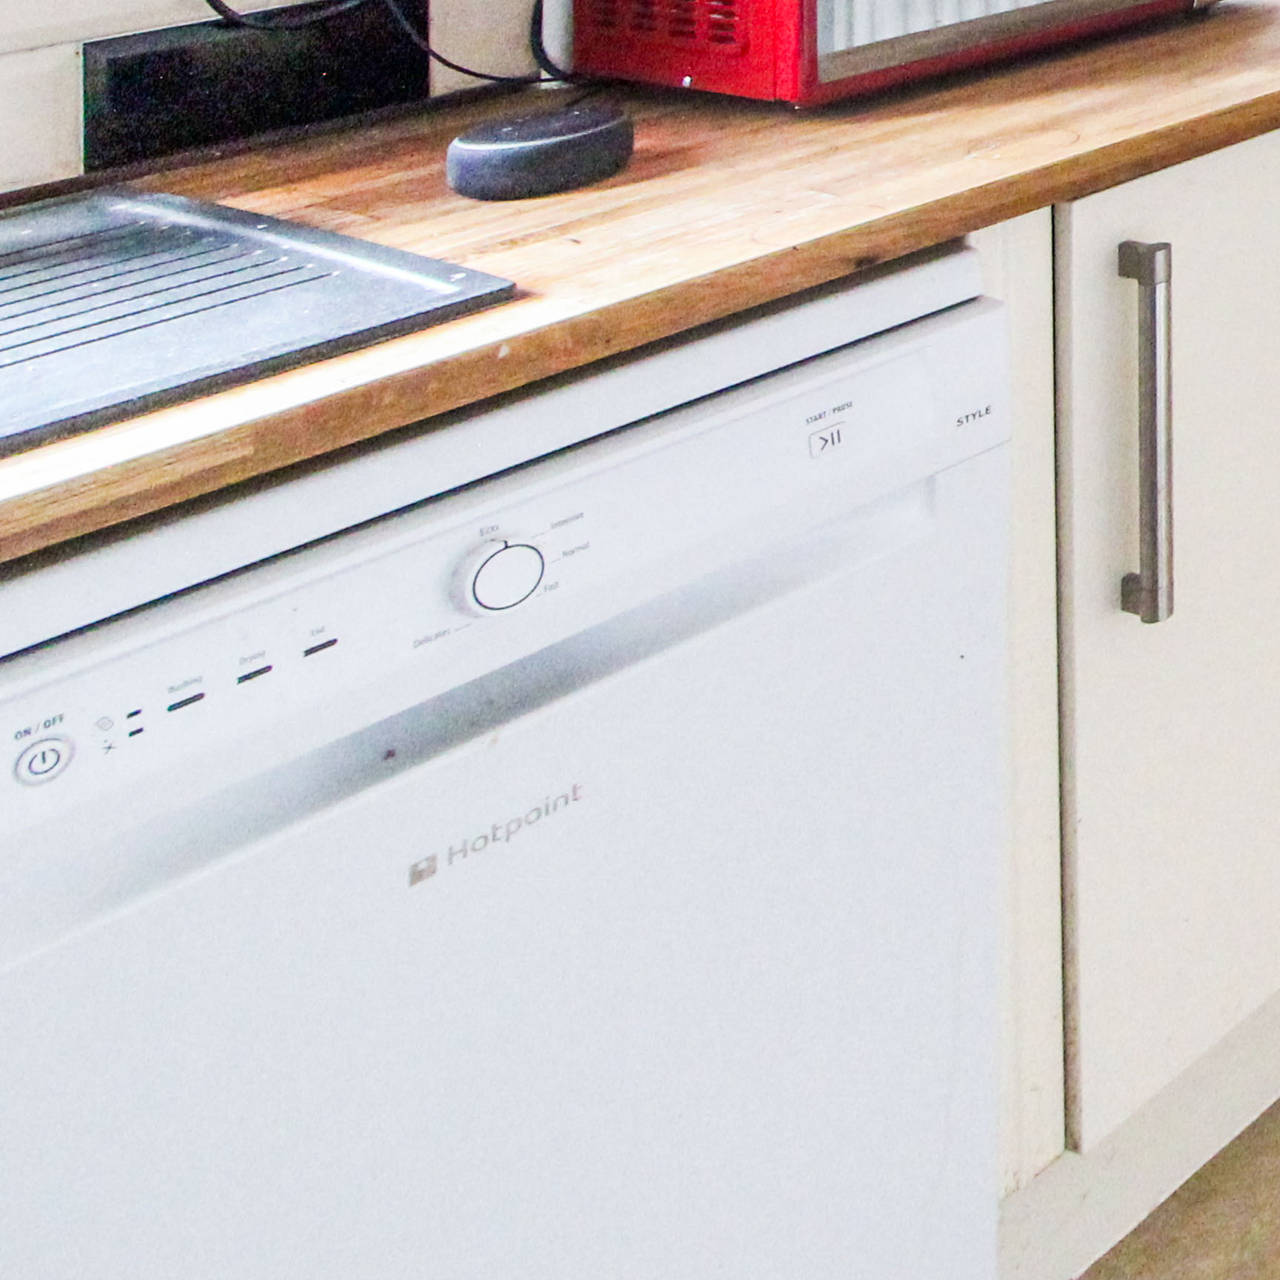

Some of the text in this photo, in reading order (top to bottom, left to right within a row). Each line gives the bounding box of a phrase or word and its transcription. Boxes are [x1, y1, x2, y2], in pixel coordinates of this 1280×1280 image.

[956, 405, 992, 427] STYLE
[14, 726, 32, 740] ON
[43, 712, 64, 729] OFF
[447, 783, 583, 866] Hotpoint
